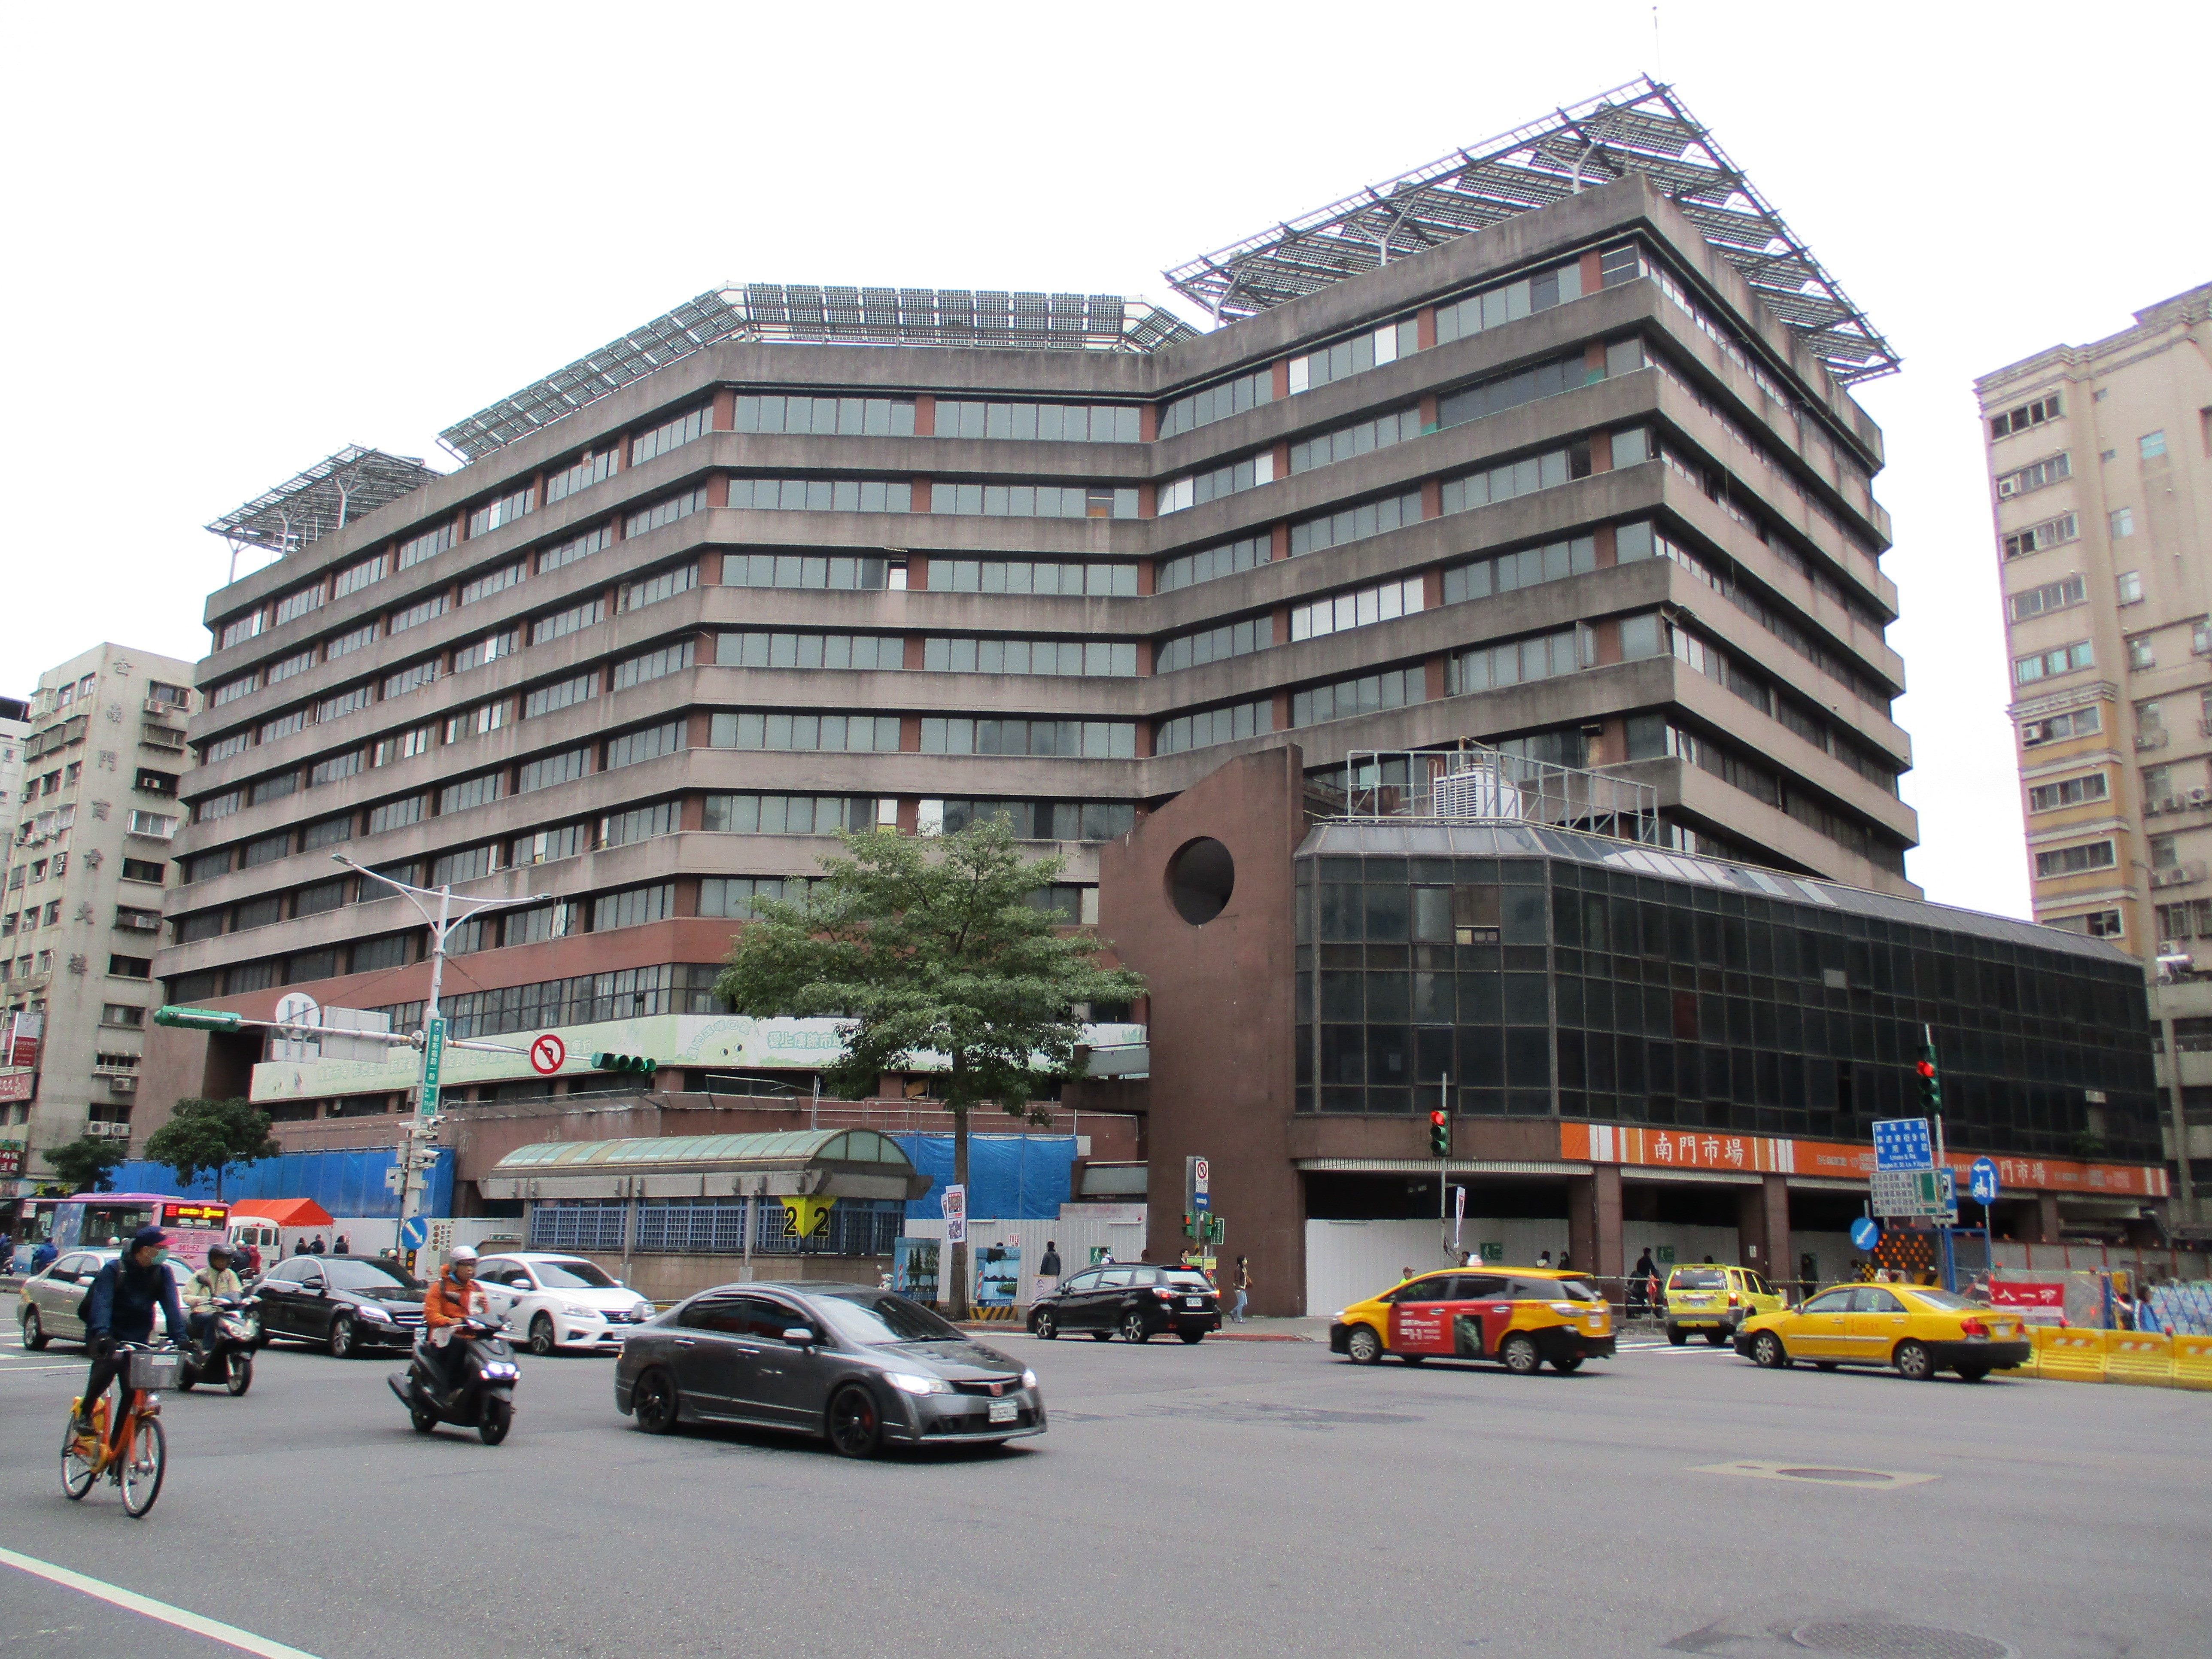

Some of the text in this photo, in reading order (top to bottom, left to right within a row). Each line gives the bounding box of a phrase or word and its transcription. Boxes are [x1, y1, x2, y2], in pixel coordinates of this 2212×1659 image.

[1655, 1131, 1743, 1167] 南門市場
[783, 1206, 797, 1236] 2
[813, 1207, 830, 1237] 2
